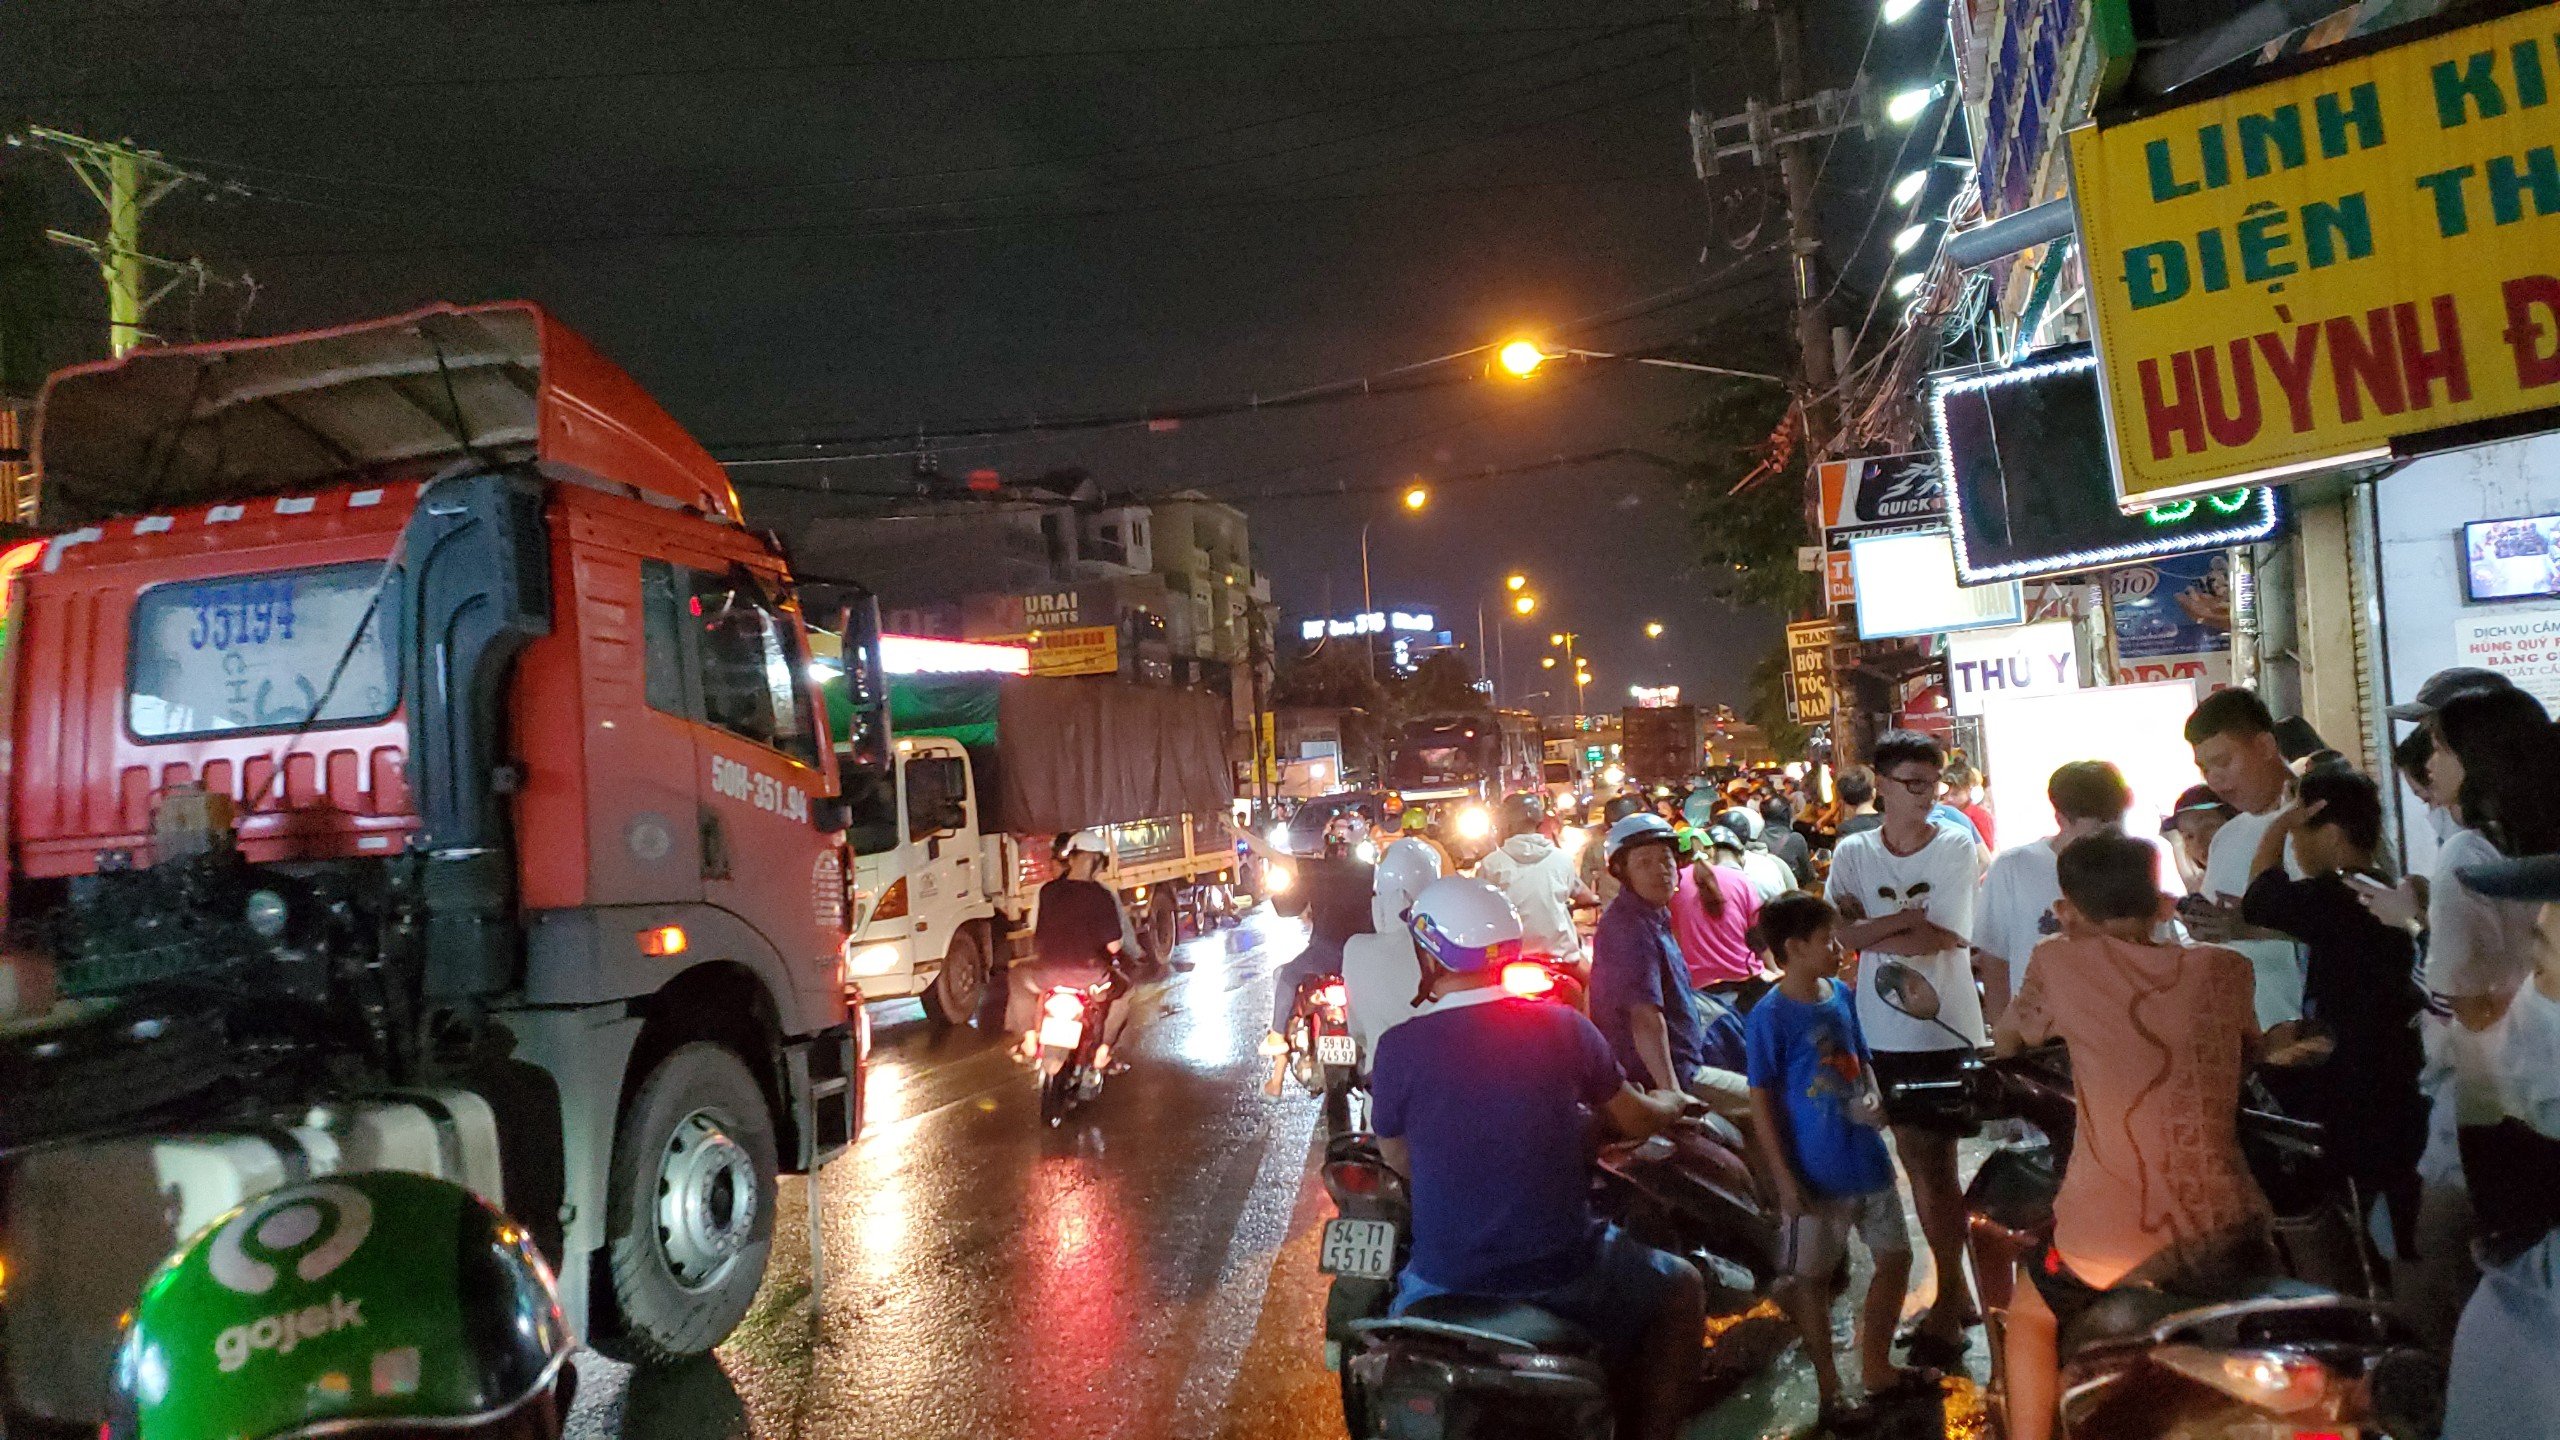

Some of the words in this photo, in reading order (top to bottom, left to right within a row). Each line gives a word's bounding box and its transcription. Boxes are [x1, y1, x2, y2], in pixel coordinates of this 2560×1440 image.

[2145, 82, 2387, 203] LINH
[2431, 33, 2560, 129] KI
[2119, 191, 2375, 311] ĐIỆN
[2137, 294, 2473, 462] HUỲNH
[1878, 500, 1930, 516] QUICK
[1026, 611, 1079, 625] PAINTS
[1795, 630, 1831, 645] THAN
[1799, 672, 1826, 695] TÓC
[1955, 650, 2032, 692] THÚ
[2048, 652, 2071, 683] Y
[215, 1292, 368, 1373] gojek
